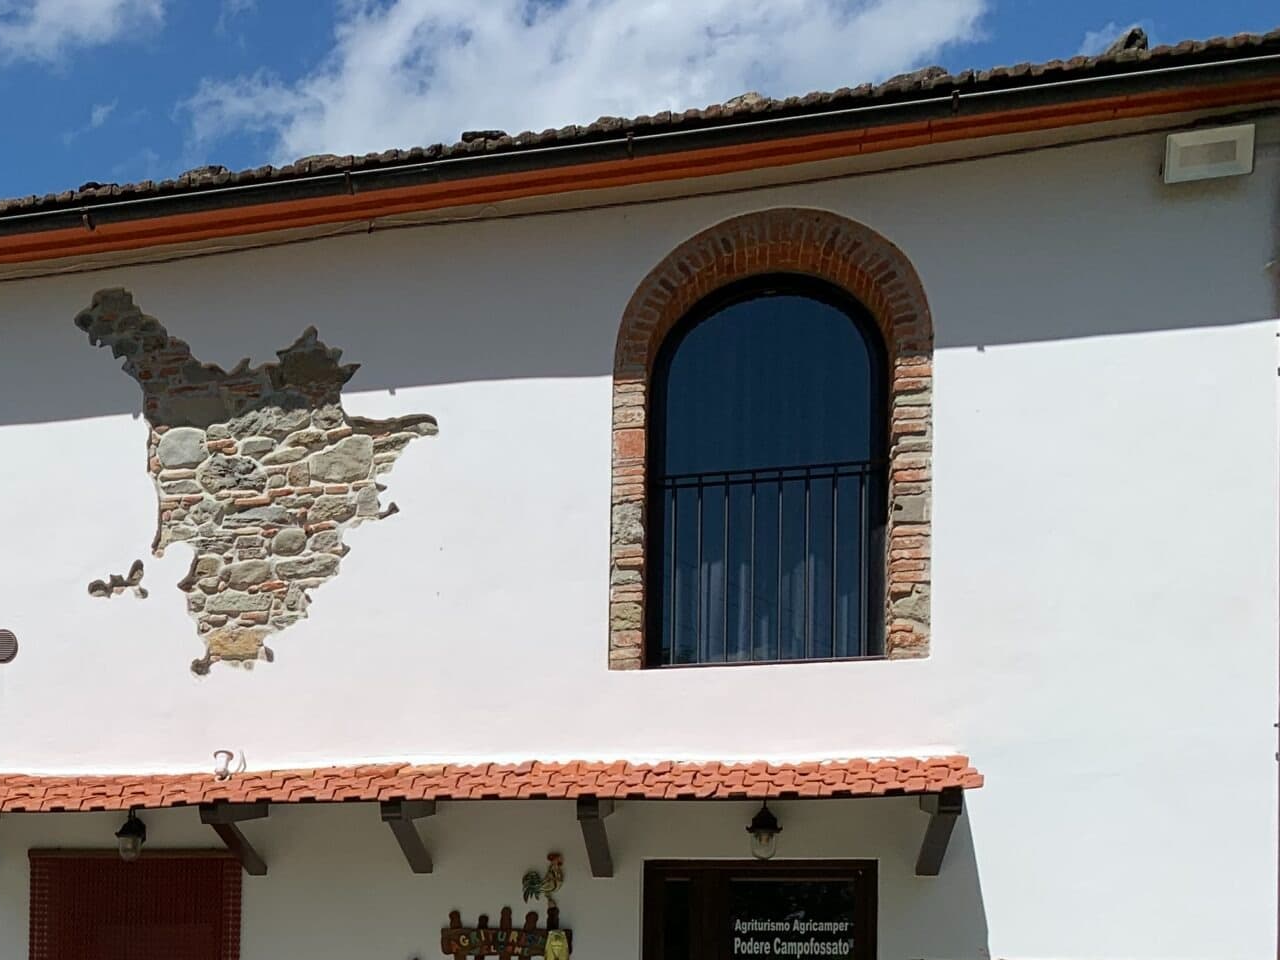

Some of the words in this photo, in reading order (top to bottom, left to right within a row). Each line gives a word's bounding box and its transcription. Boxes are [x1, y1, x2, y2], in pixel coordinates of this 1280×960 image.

[735, 919, 790, 934] Agriturismo
[793, 919, 848, 934] Agricamper
[734, 937, 770, 955] Podere
[773, 937, 849, 959] Campofossato
